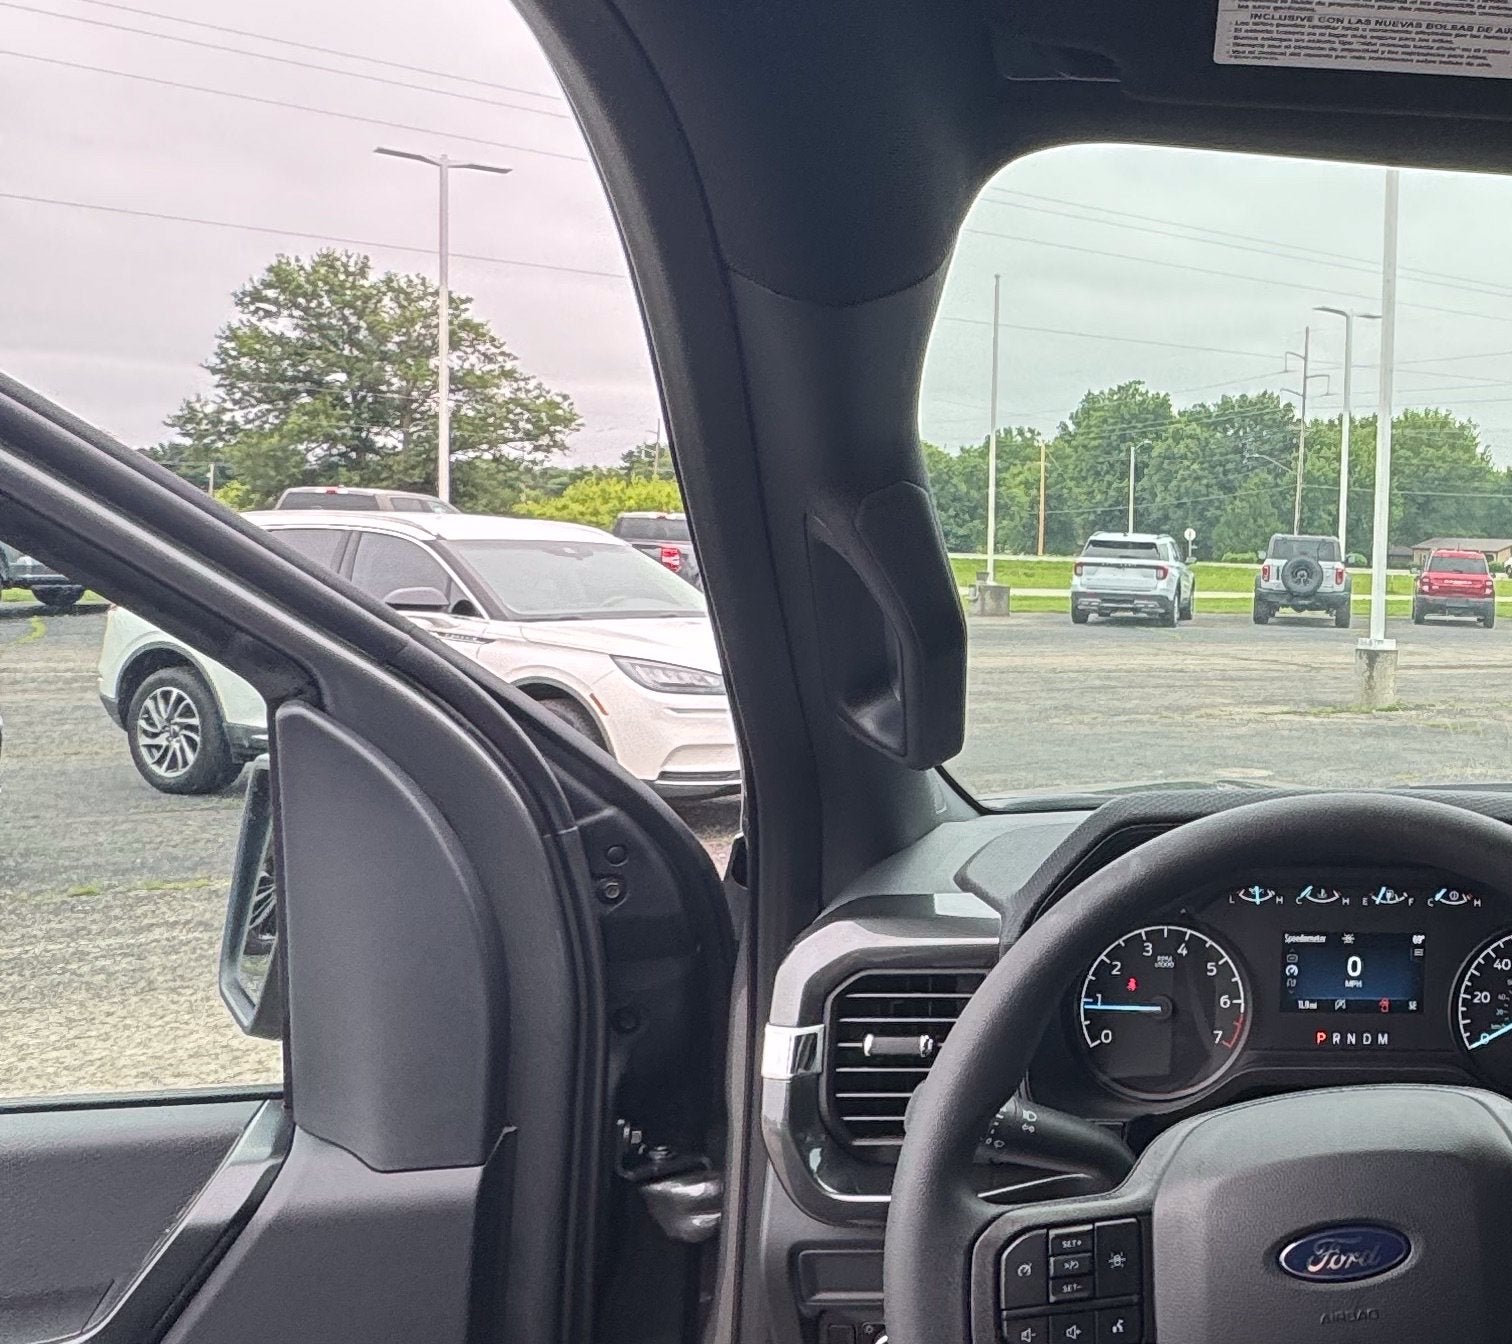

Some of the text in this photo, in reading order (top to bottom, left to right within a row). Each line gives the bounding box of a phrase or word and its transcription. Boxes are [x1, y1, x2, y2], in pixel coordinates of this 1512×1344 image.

[1250, 12, 1314, 23] INCLUSIVE
[1318, 15, 1345, 25] CON
[1347, 18, 1371, 26] LAS
[1374, 19, 1423, 30] NUEVAS
[1425, 22, 1474, 32] BOLSAS
[1476, 25, 1494, 34] DE
[1229, 895, 1235, 904] L
[1275, 895, 1284, 905] H
[1342, 896, 1350, 906] H
[1362, 897, 1369, 906] E
[1408, 897, 1414, 907] F
[1473, 898, 1482, 907] H
[1143, 942, 1153, 956] 3
[1177, 943, 1188, 956] 4
[1111, 962, 1121, 975] 2
[1206, 962, 1217, 976] 5
[1347, 955, 1362, 977] 0
[1493, 958, 1512, 971] 40
[1345, 979, 1362, 989] MPH
[1219, 994, 1231, 1009] 6
[1473, 991, 1490, 1004] 20
[1100, 1029, 1113, 1044] 0
[1212, 1030, 1223, 1044] 7
[1316, 1032, 1389, 1045] P R N D M
[1306, 1236, 1383, 1273] Ford
